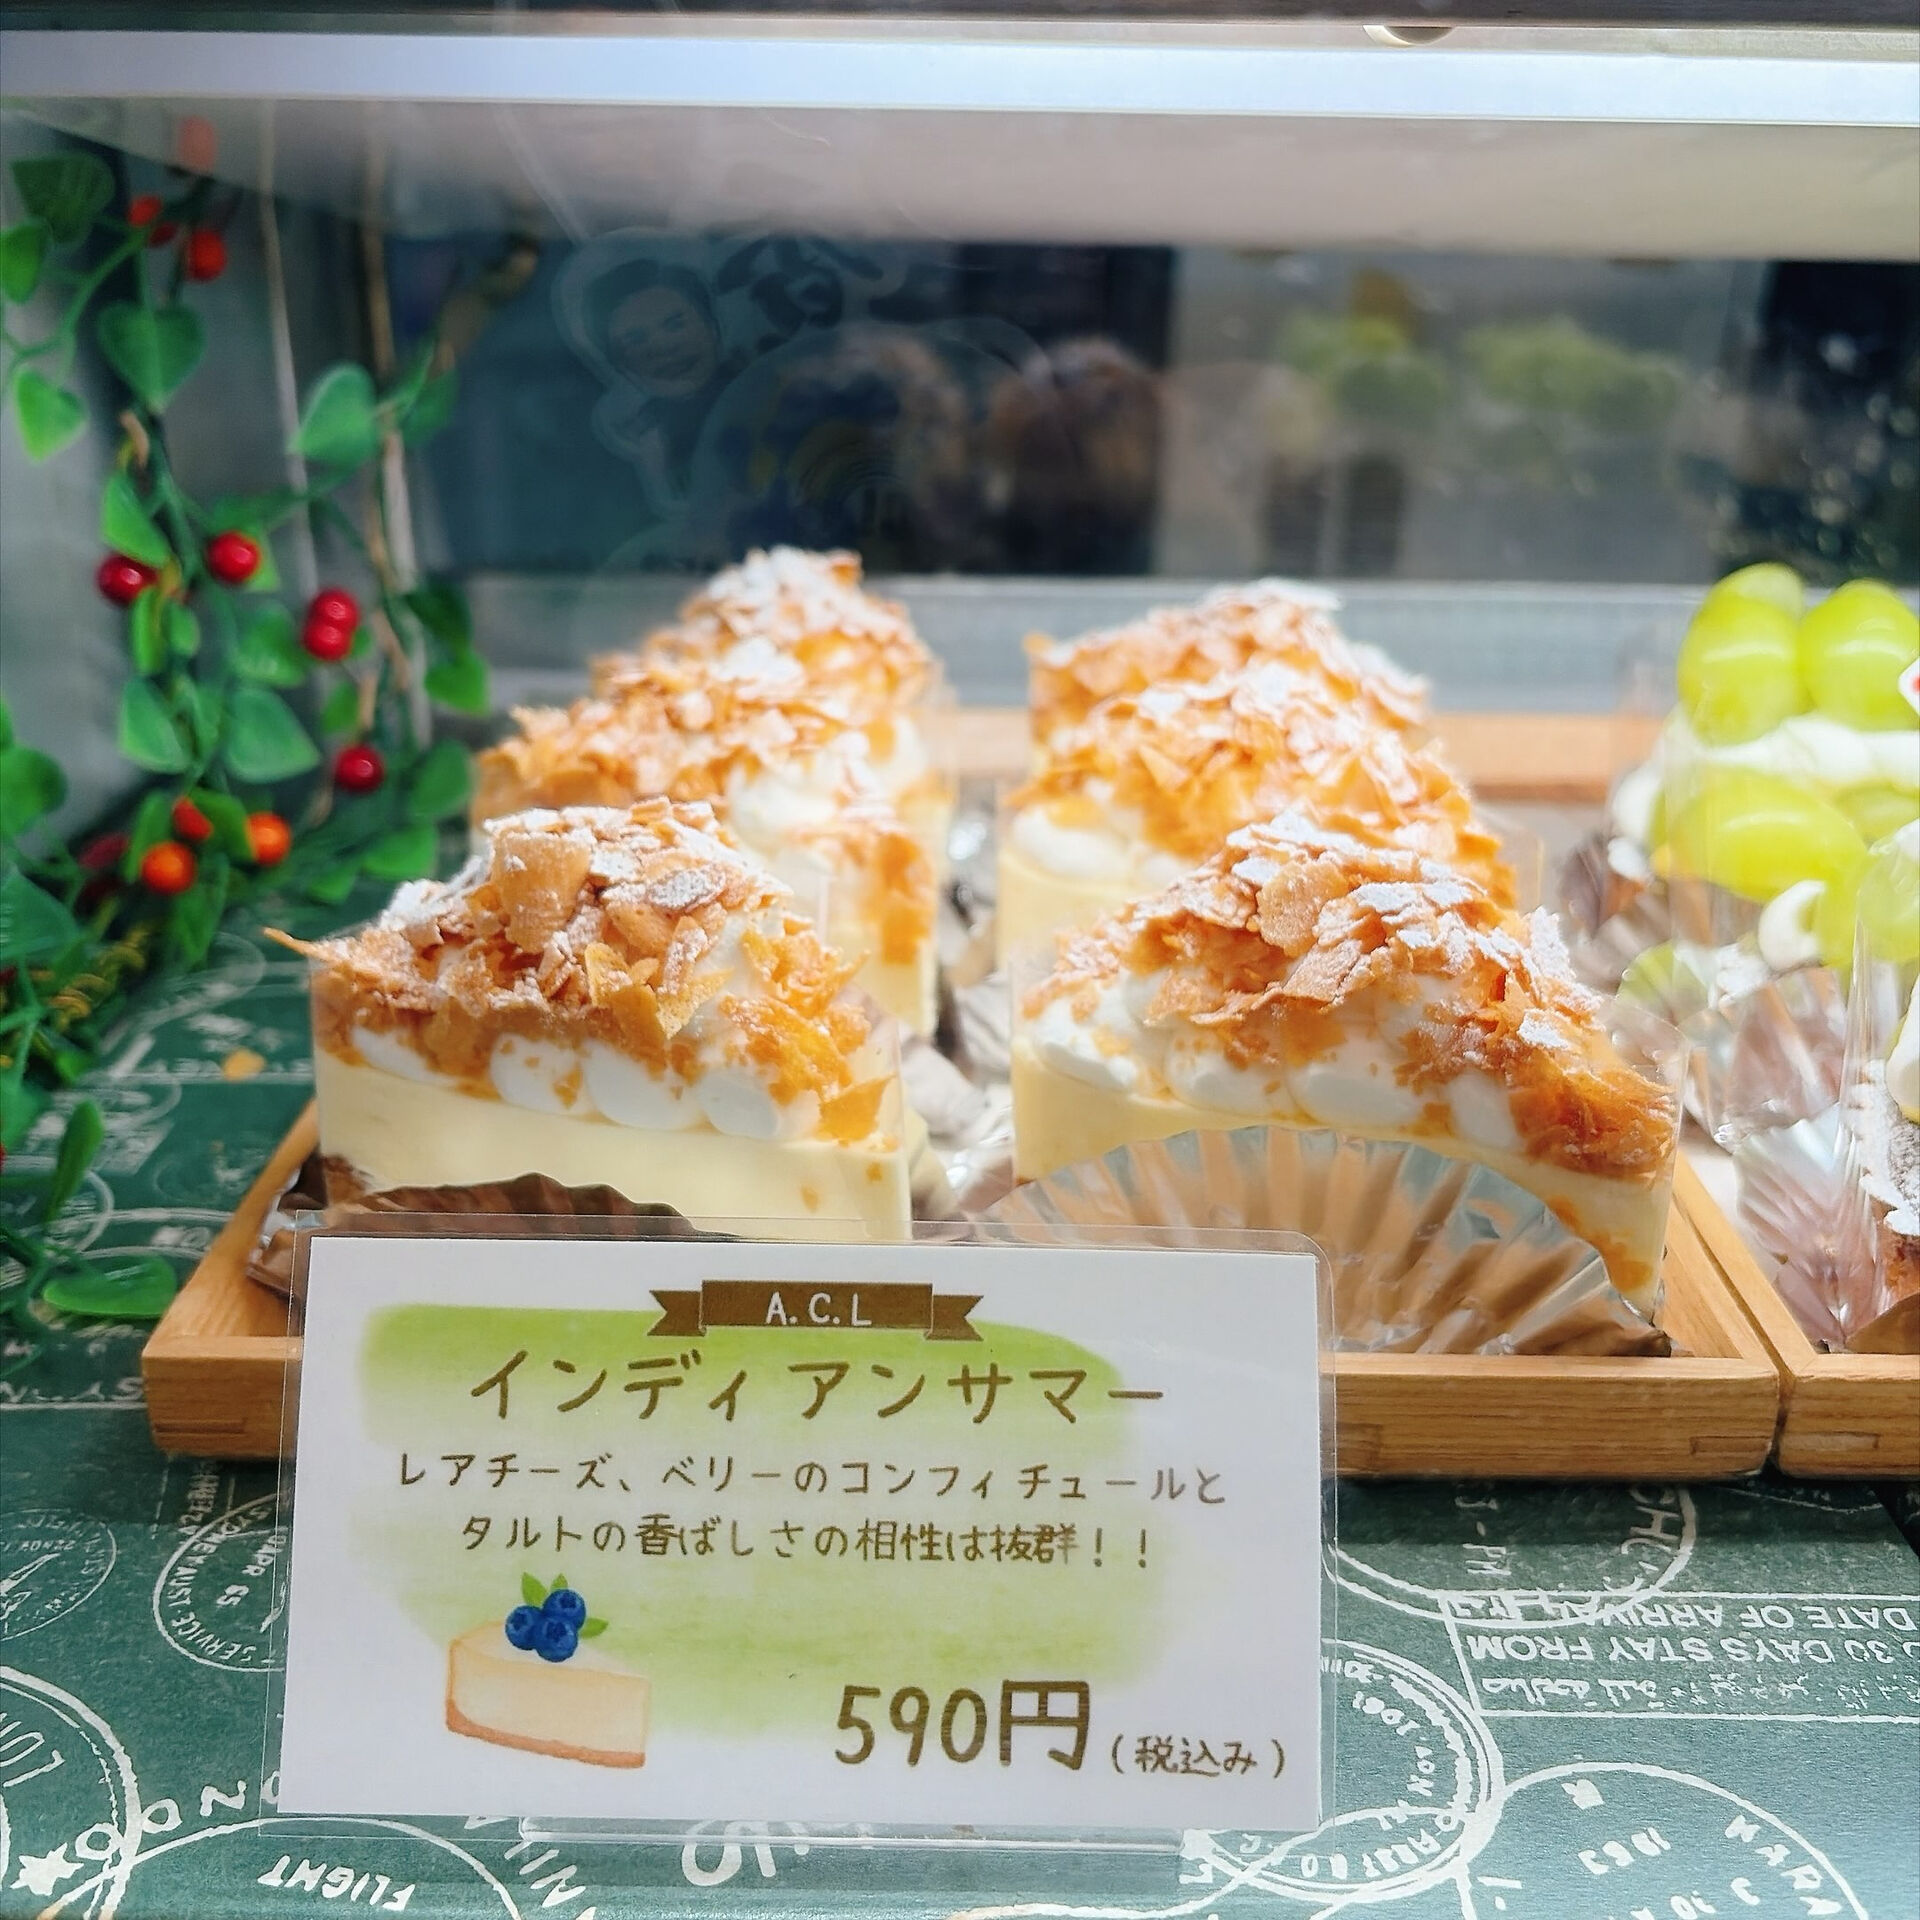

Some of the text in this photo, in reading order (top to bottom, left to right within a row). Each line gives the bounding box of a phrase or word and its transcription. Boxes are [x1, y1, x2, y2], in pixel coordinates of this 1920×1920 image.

[765, 1291, 873, 1326] A.C.L
[471, 1347, 1164, 1424] インディアンサマー
[399, 1451, 1226, 1505] レアチーズ、ベリーのコンフィチュールと
[460, 1514, 1149, 1569] タルトの香ばしさの相性は抜群！！
[1740, 1605, 1795, 1629] OF
[1801, 1605, 1918, 1631] DATE
[1466, 1634, 1594, 1662] FROM
[1608, 1636, 1714, 1663] STAY
[1718, 1637, 1835, 1666] DAYS
[834, 1677, 1092, 1771] 590円
[257, 1853, 416, 1912] FLIGHT
